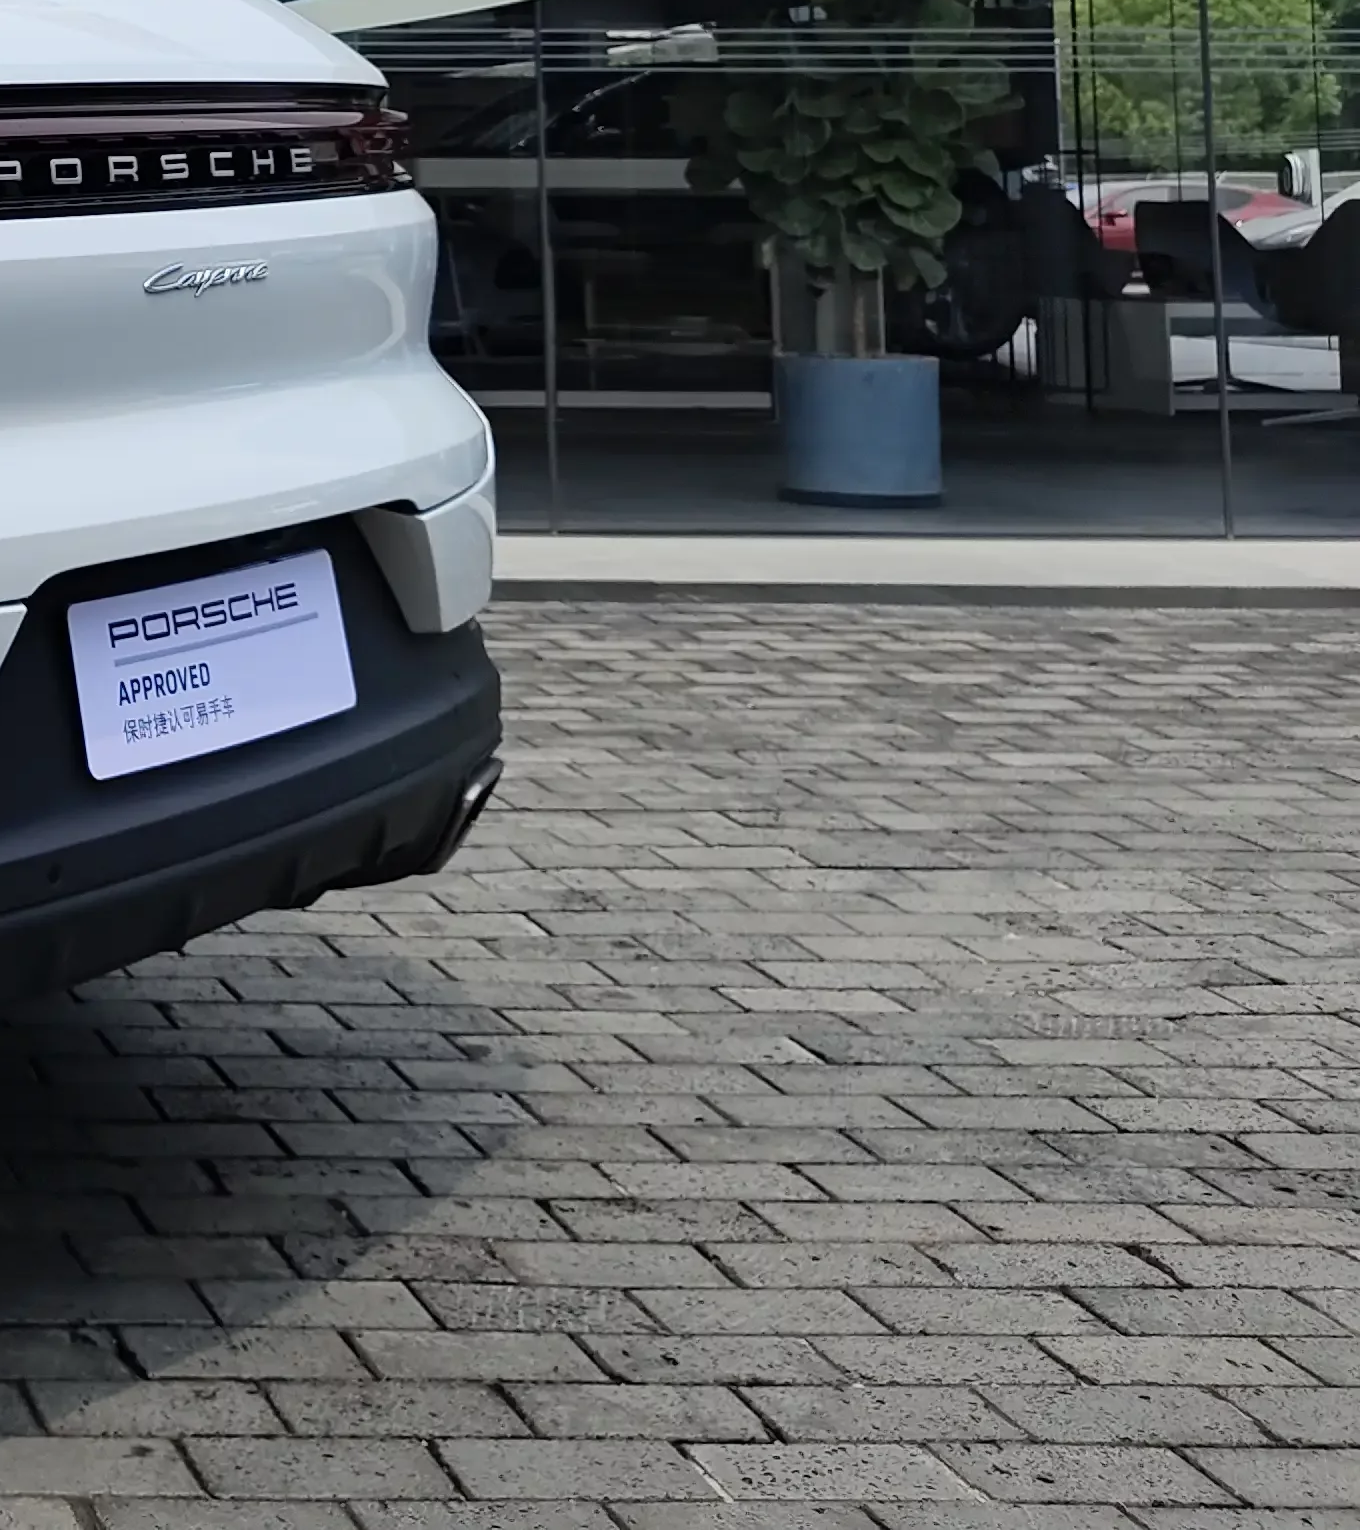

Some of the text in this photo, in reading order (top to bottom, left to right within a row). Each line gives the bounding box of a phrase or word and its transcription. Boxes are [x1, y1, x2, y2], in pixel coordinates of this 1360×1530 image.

[143, 258, 270, 298] Cayenne
[108, 582, 299, 648] PORSCHE
[118, 662, 211, 706] APPROVED
[123, 695, 235, 744] 保时捷认可易手车
